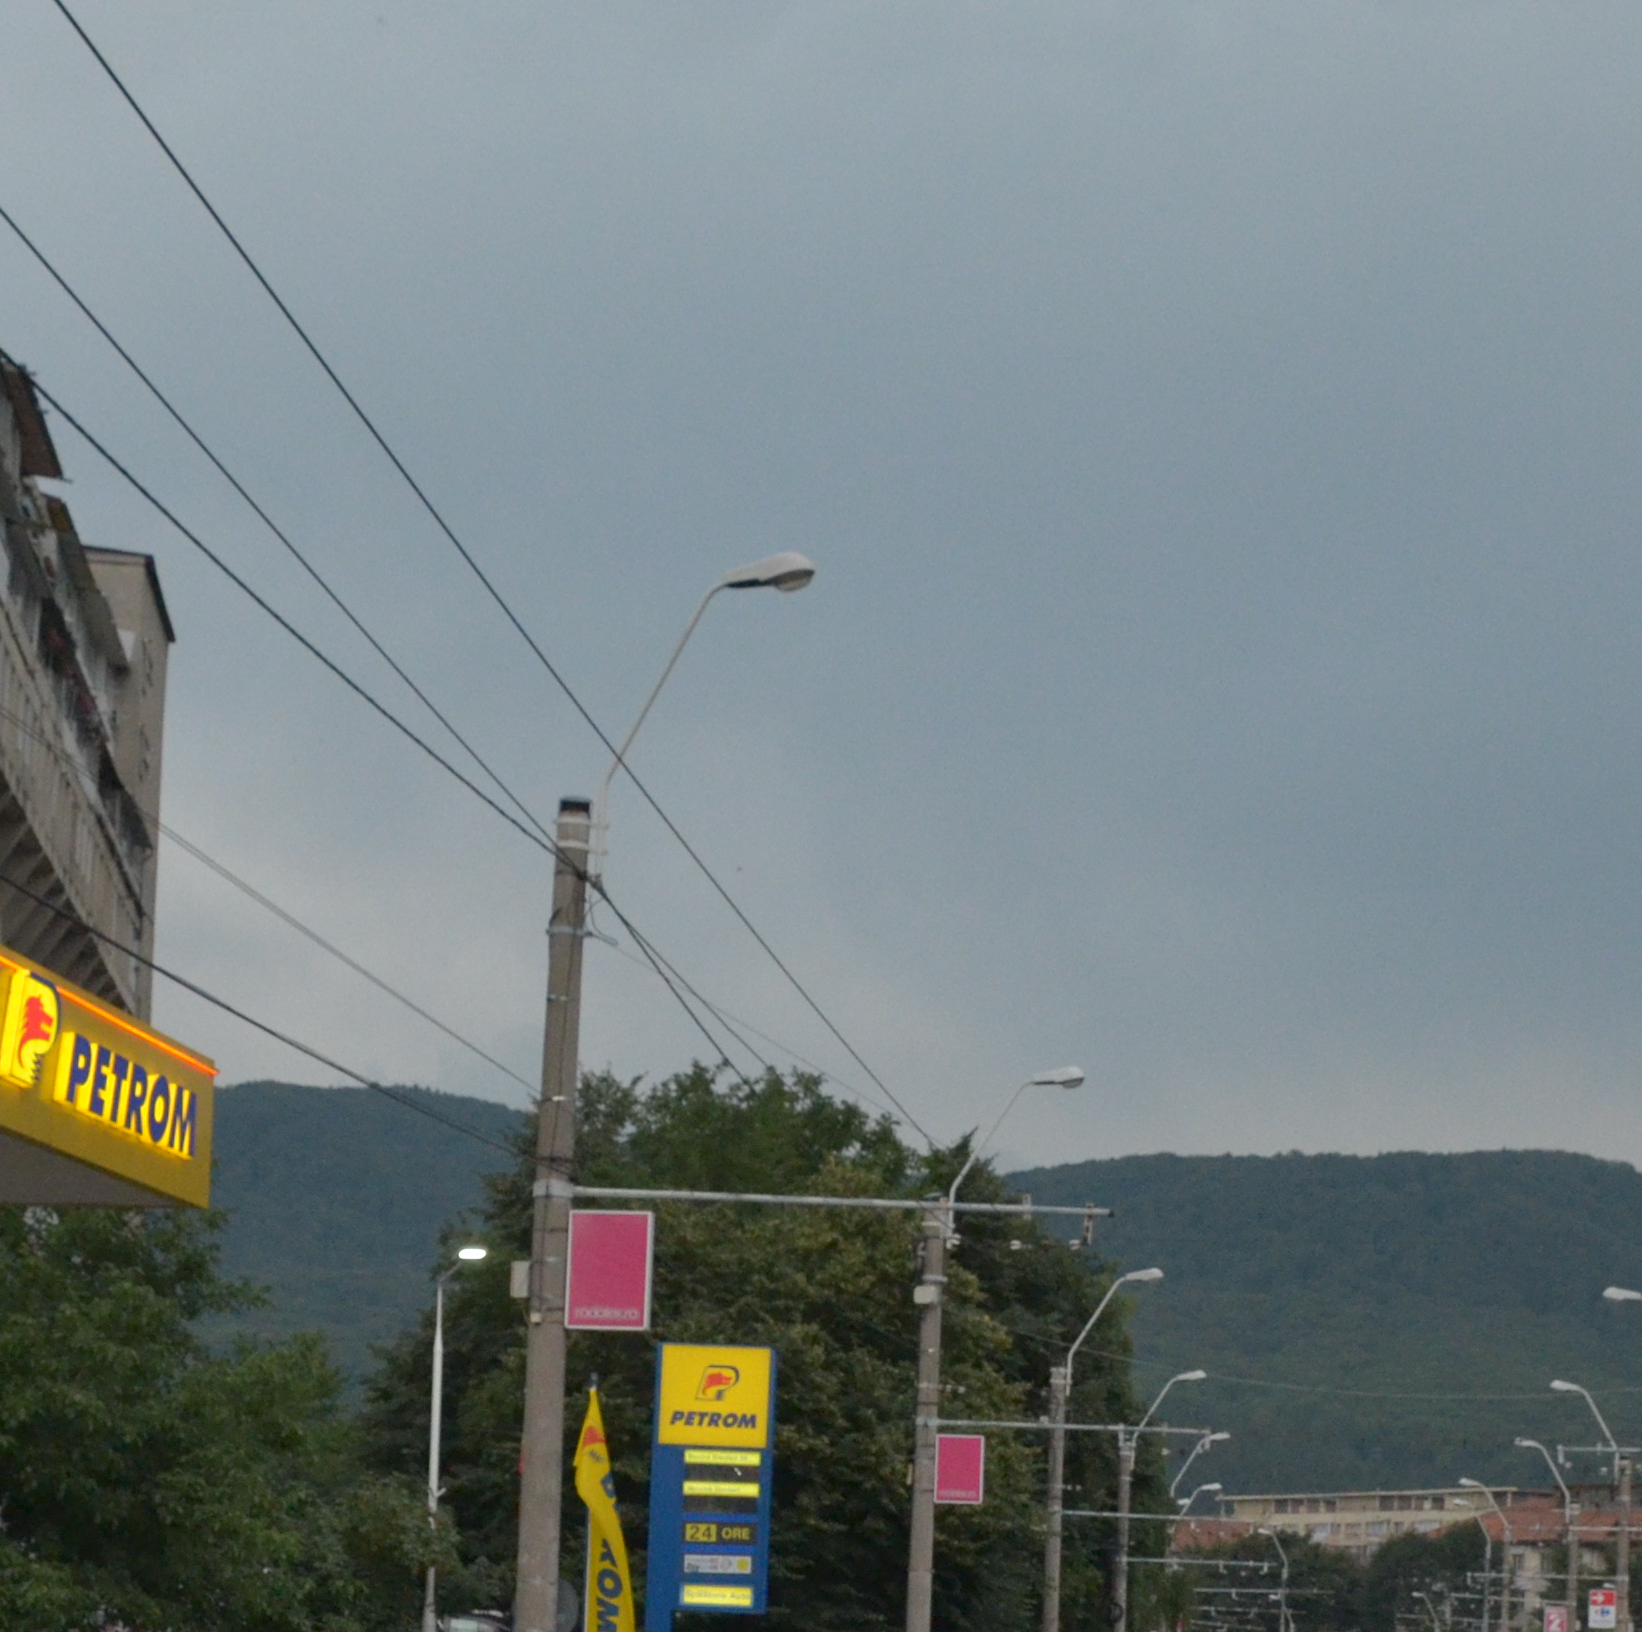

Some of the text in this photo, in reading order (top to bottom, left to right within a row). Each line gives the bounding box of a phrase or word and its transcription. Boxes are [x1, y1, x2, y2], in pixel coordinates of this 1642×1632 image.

[66, 1033, 197, 1157] PETROM
[670, 1410, 757, 1429] PETROM
[690, 1525, 750, 1540] 24 ORE
